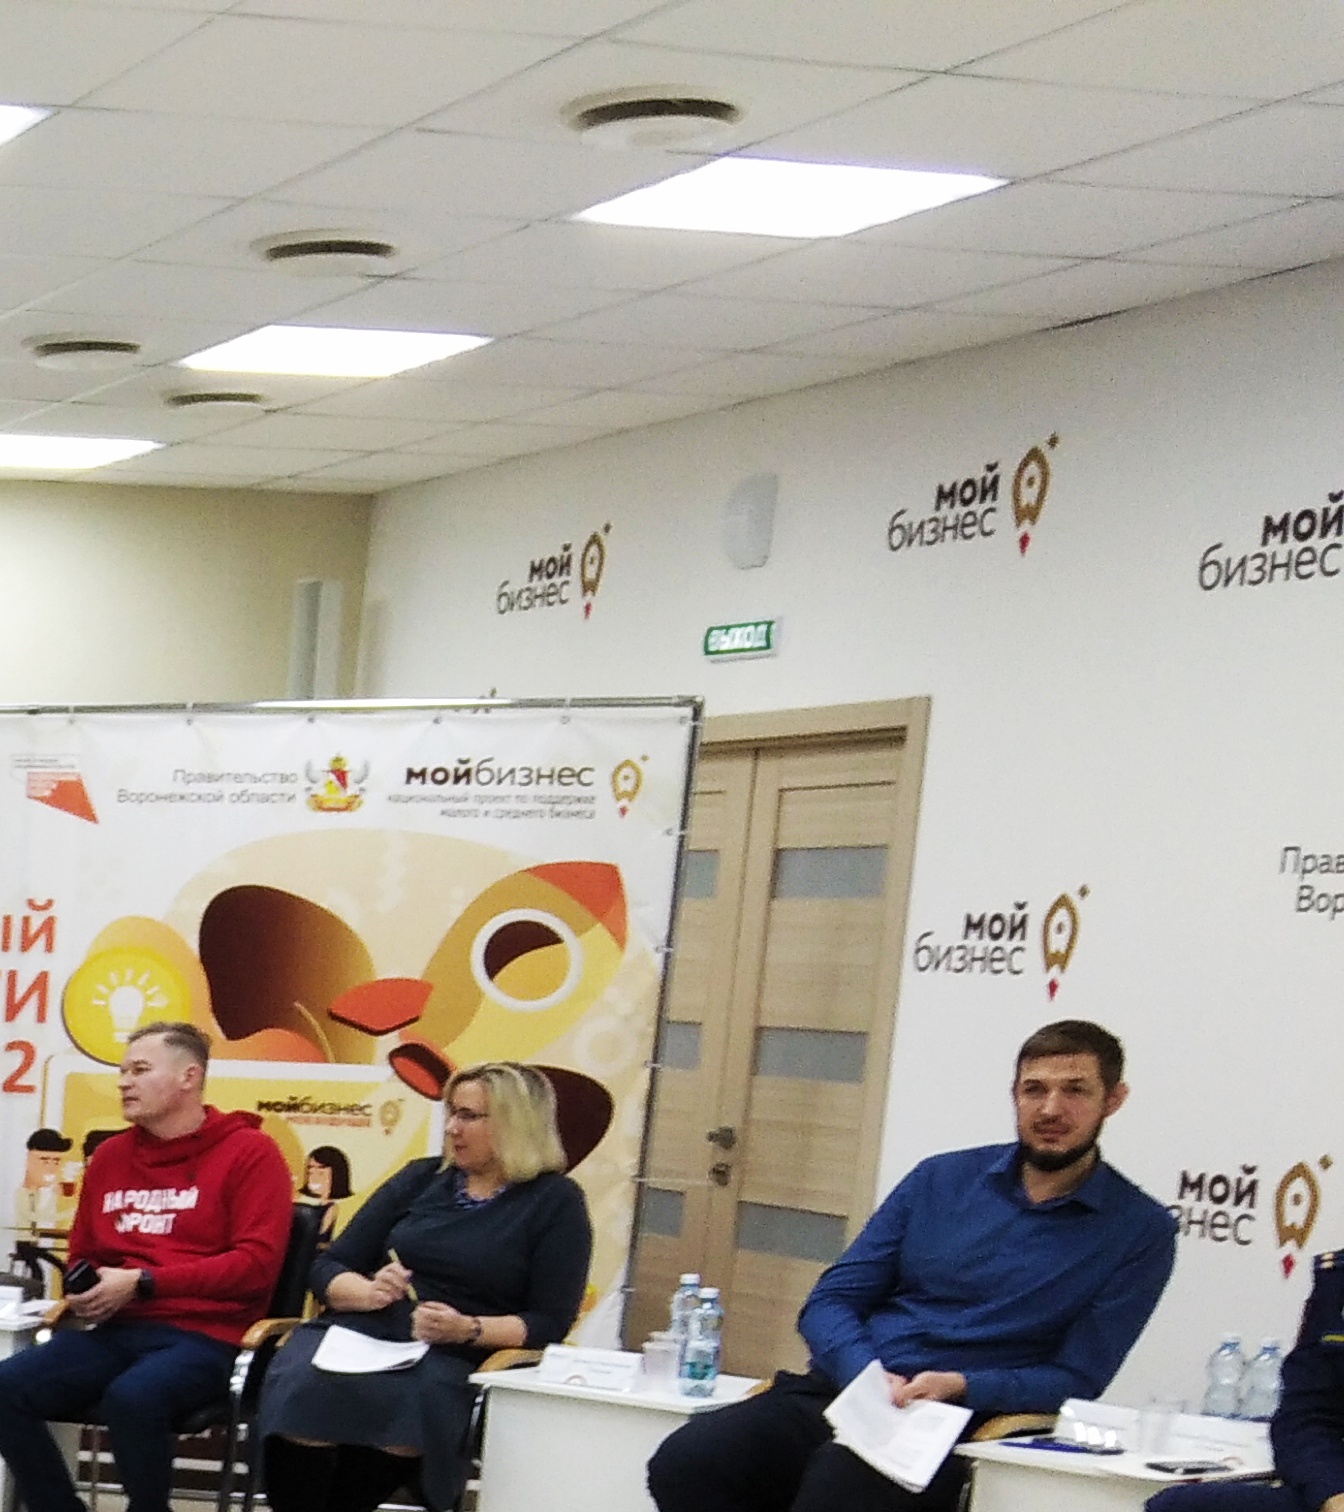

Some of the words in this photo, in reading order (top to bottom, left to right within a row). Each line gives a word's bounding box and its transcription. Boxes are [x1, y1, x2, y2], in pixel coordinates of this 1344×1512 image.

[935, 461, 1000, 508] мой
[886, 503, 998, 552] бизнес
[1261, 492, 1344, 546] мой
[527, 543, 573, 583] мой
[1198, 539, 1344, 593] бизнес
[495, 579, 571, 616] бизнес
[708, 624, 768, 651] ВЫХОД
[173, 768, 299, 787] Правительство
[406, 757, 594, 788] мойбизнес
[116, 788, 225, 805] Воронежской
[229, 788, 297, 804] области
[964, 902, 1029, 942] мой
[913, 931, 1026, 976] бизнес
[102, 1186, 200, 1214] НАРОДНЫЙ
[1178, 1164, 1261, 1209] мой
[113, 1211, 178, 1235] ФРОНТ
